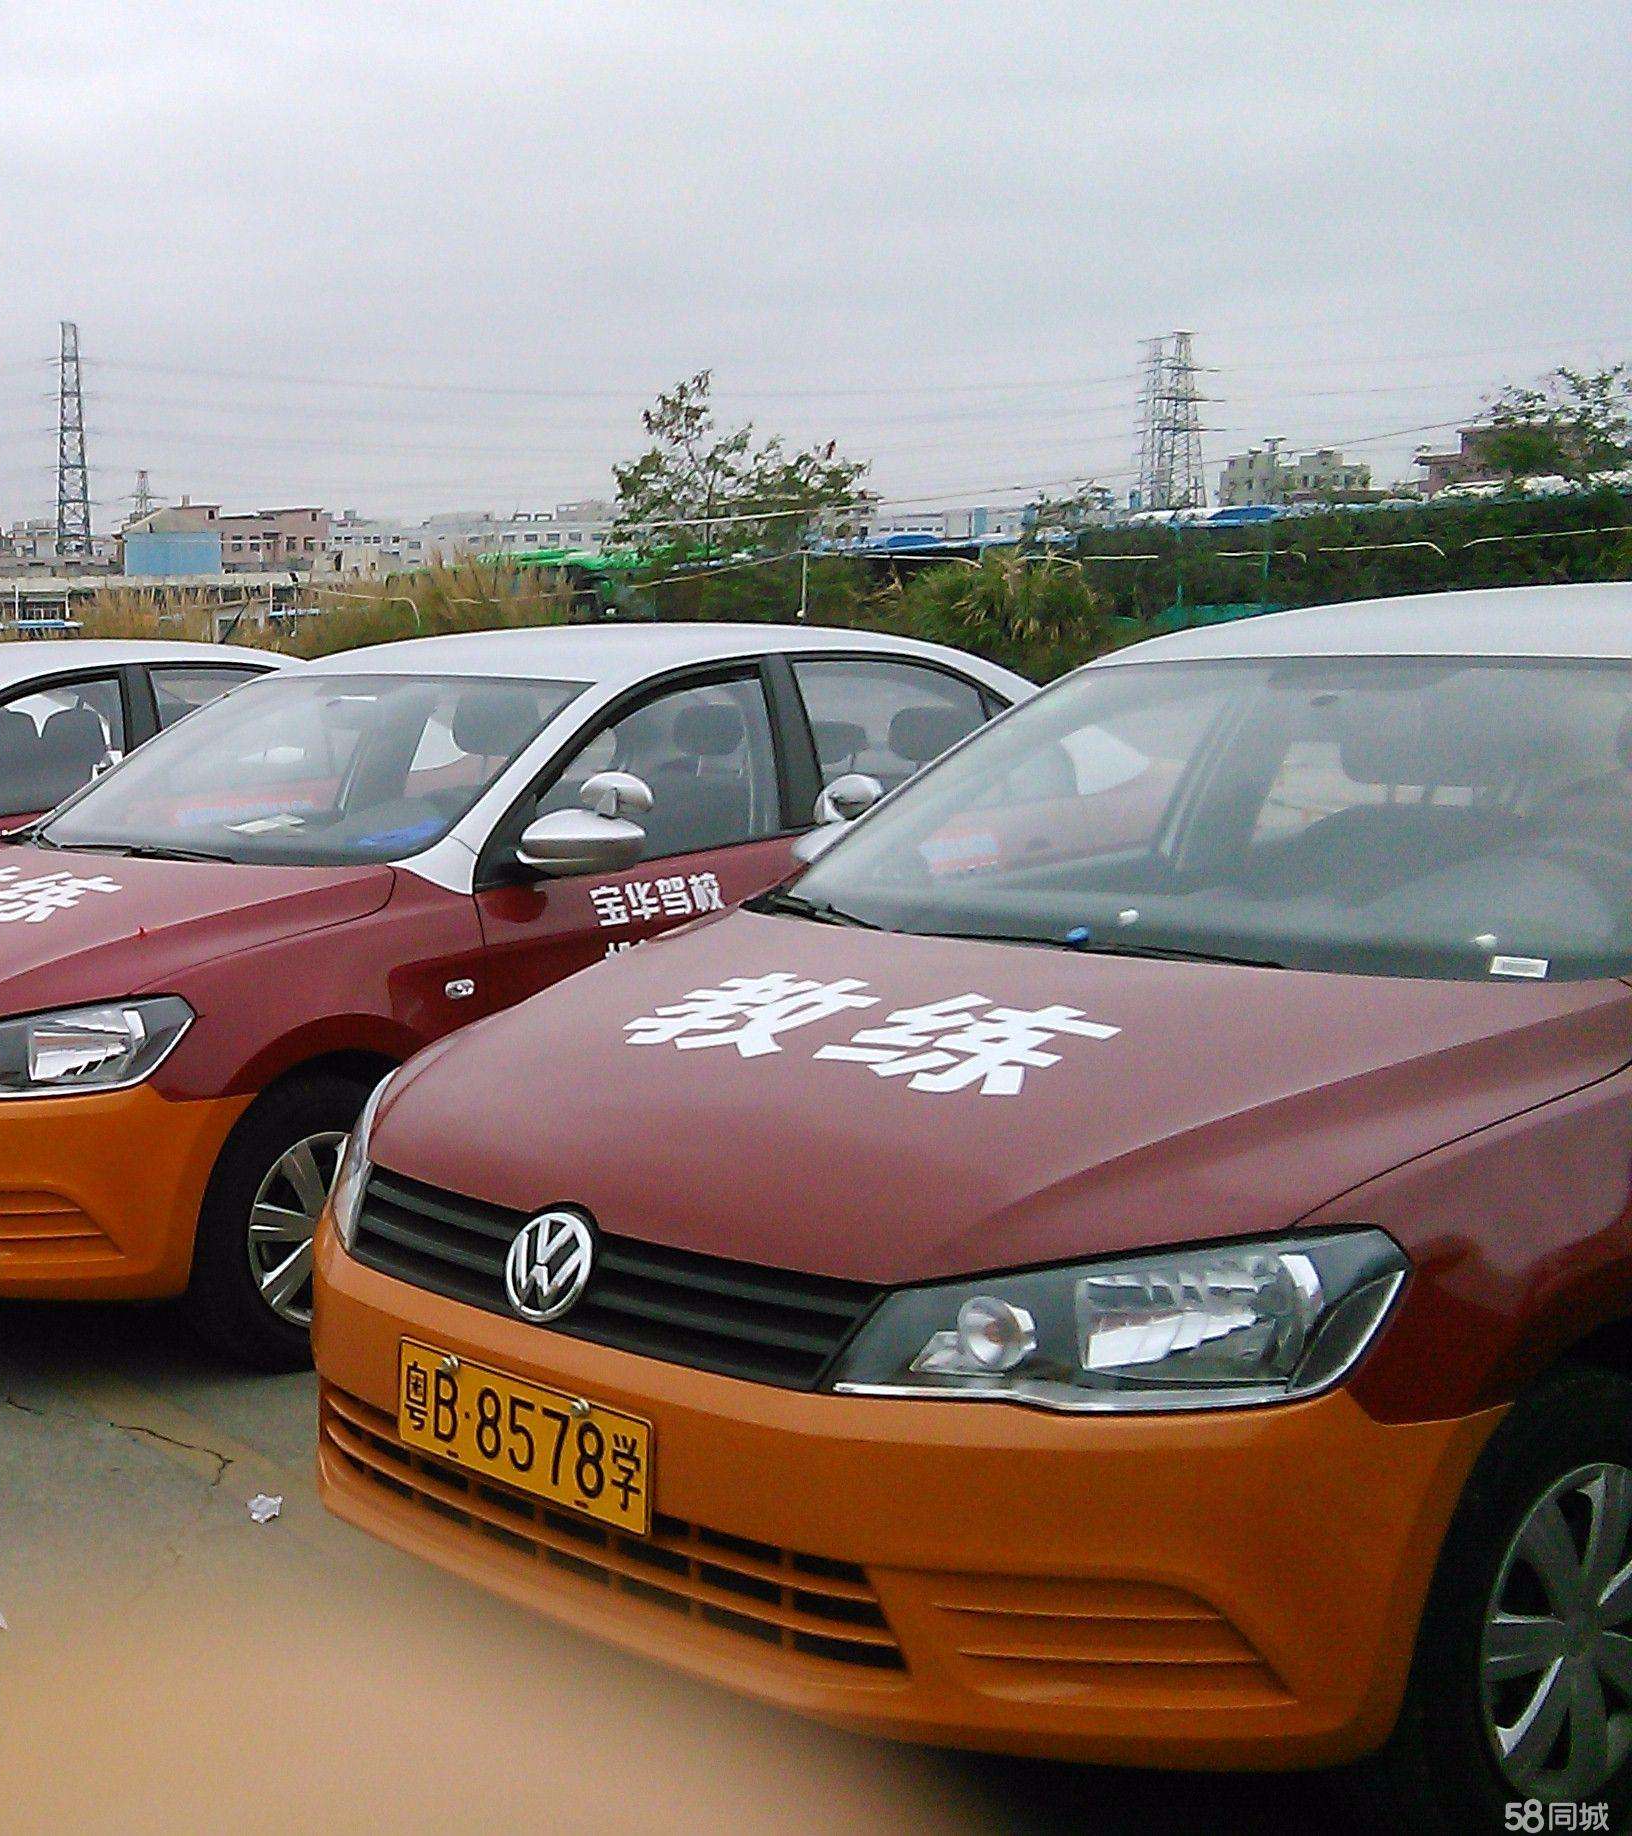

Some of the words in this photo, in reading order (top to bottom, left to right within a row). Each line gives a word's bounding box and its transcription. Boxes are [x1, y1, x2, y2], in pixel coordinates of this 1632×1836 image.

[589, 872, 726, 927] 宝华驾校
[622, 971, 1123, 1097] 教练
[404, 1360, 642, 1512] 粤B·8578学
